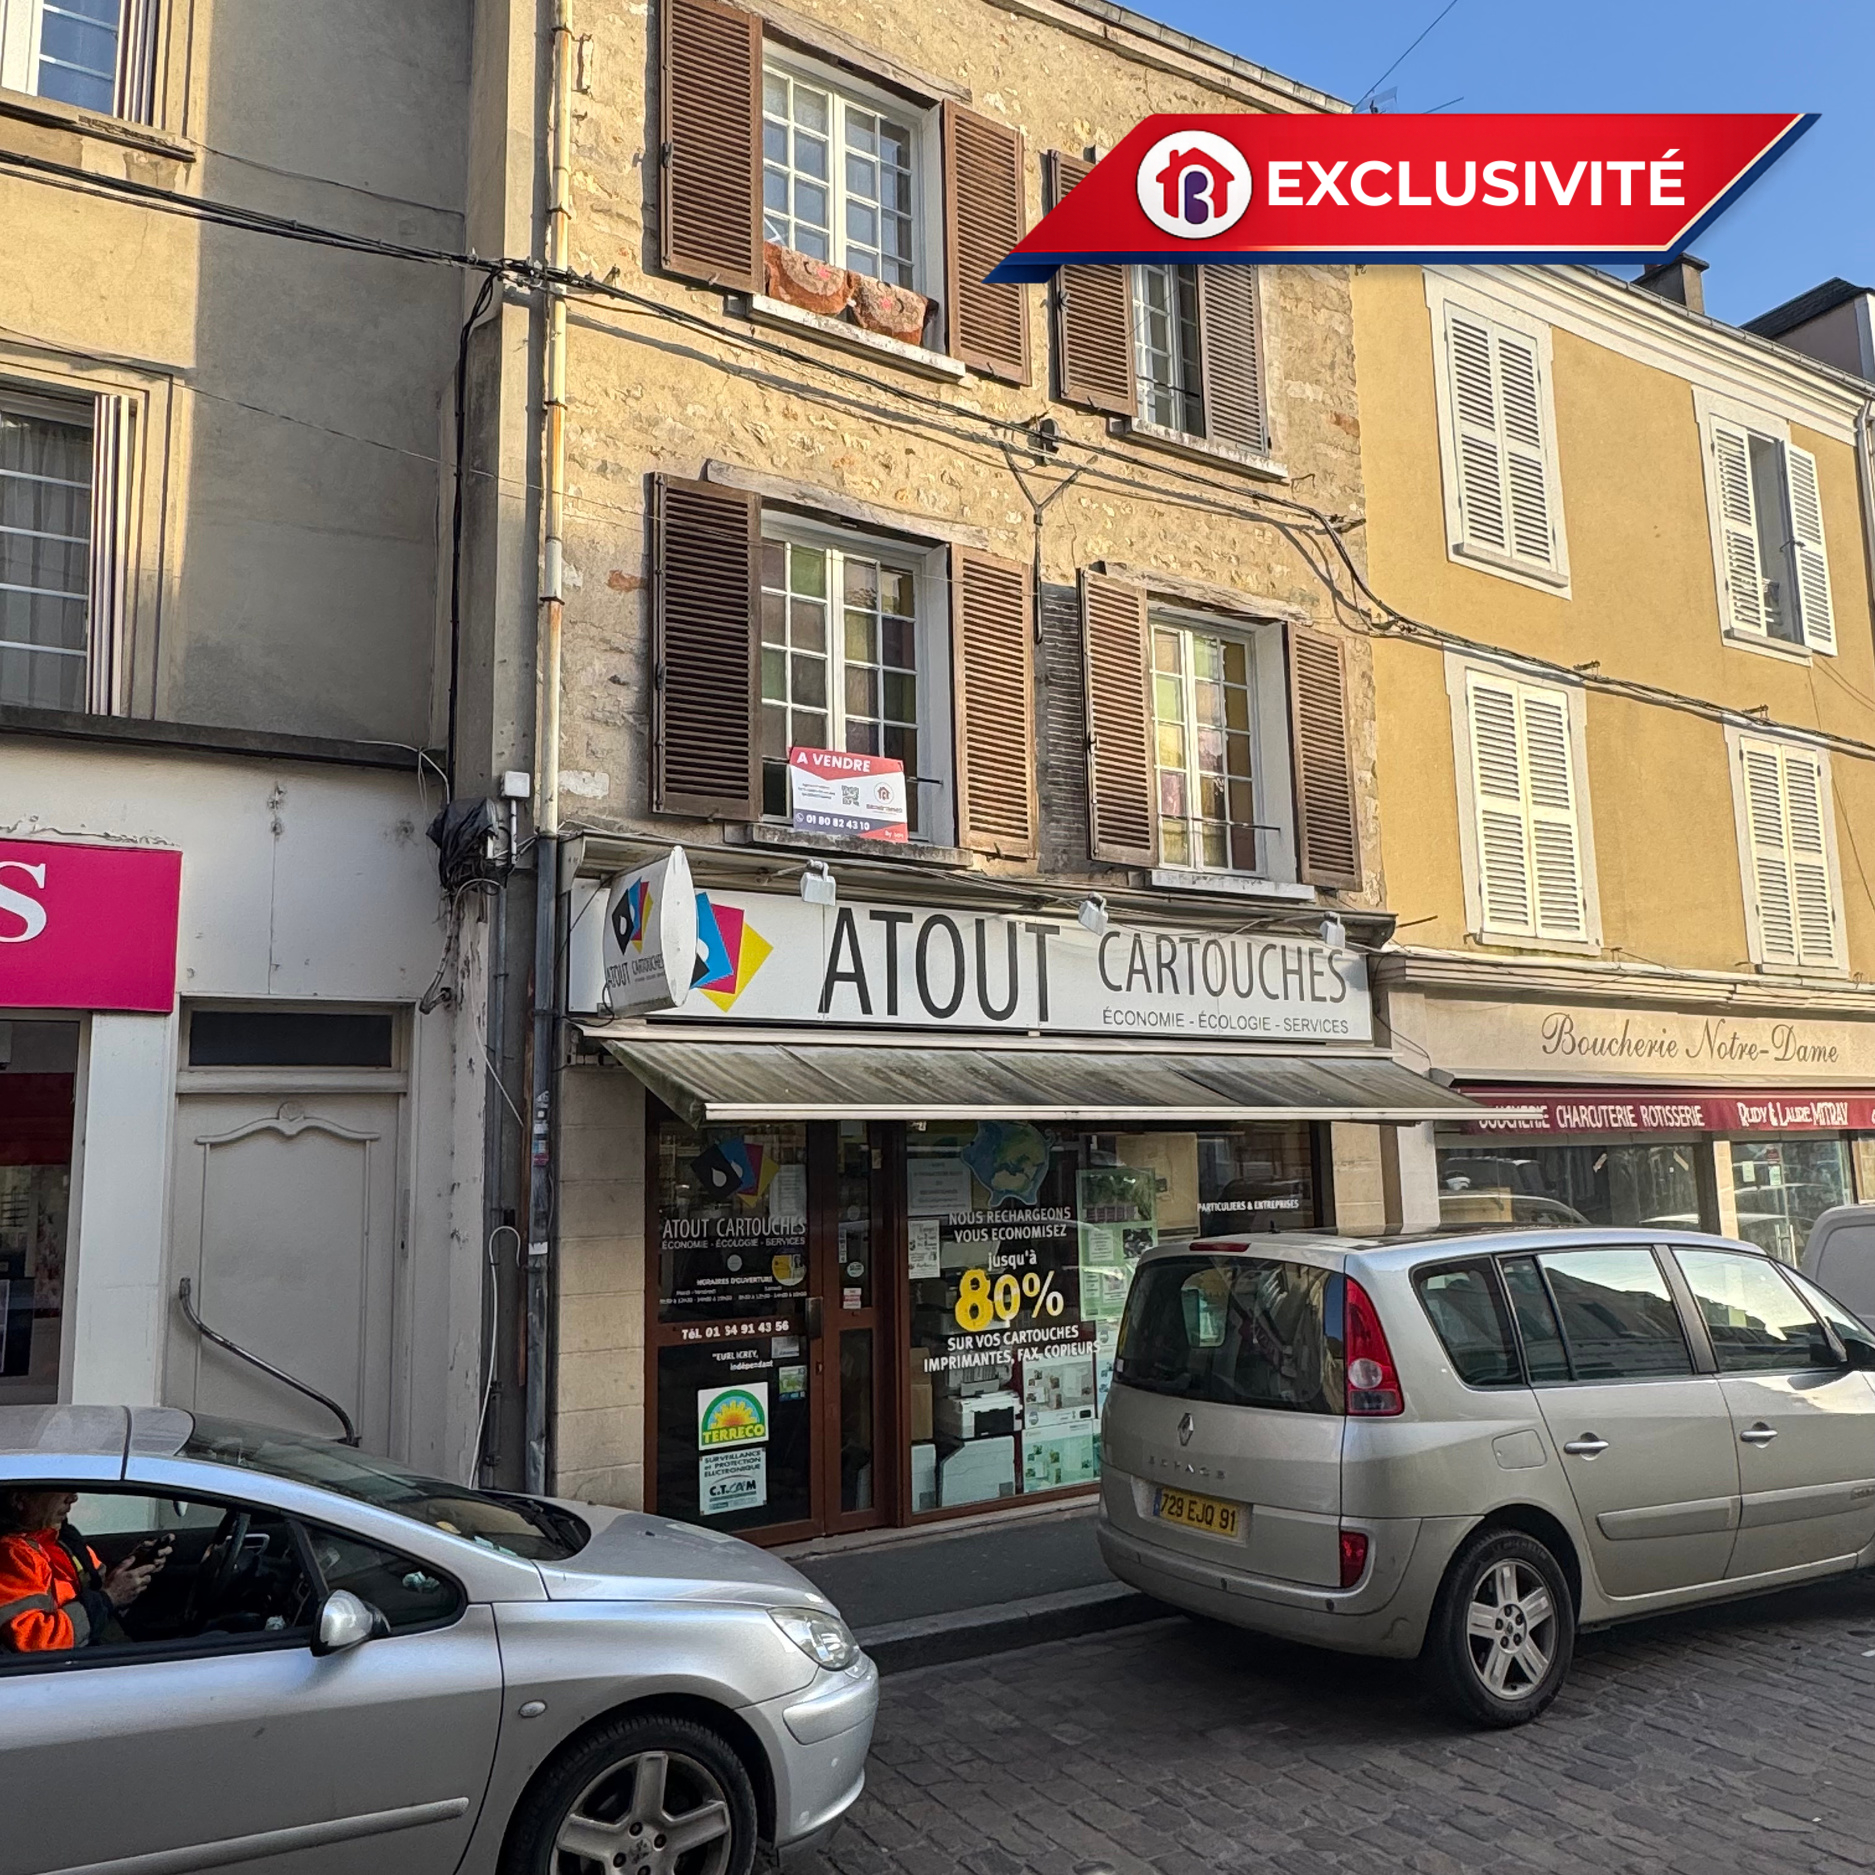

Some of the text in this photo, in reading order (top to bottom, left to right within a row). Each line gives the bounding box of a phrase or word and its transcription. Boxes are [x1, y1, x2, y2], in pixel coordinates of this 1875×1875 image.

[797, 752, 871, 772] A VENDRE
[806, 815, 817, 825] 01
[846, 821, 859, 831] 43
[859, 822, 870, 831] 10
[606, 960, 631, 989] ATOUT
[817, 906, 1347, 1022] ATOUT CARTOUCHES
[1102, 1006, 1185, 1028] ÉCONOMIE
[1198, 1013, 1271, 1032] ÉCOLOGIE
[1283, 1017, 1349, 1034] SERVICES
[1541, 1012, 1839, 1063] Boucherie Notre-Dame
[1555, 1105, 1638, 1128] CHARCUTERIE
[1639, 1105, 1705, 1127] ROTISSERIE
[949, 1206, 1072, 1226] NOUS RECHARGEONS
[1196, 1199, 1299, 1213] PARTICULIERS & ENTREPRISES
[662, 1216, 807, 1239] ATOUT CARTOUCHES
[954, 1223, 1067, 1243] VOUS ECONOMISEZ
[765, 1236, 806, 1247] SERVICES
[988, 1249, 1038, 1271] jusqu'à
[955, 1268, 1065, 1332] 80%
[706, 1326, 720, 1337] 01
[724, 1324, 738, 1336] 34
[741, 1323, 755, 1334] 91
[758, 1322, 772, 1333] 43
[775, 1320, 789, 1331] 56
[948, 1325, 1079, 1351] SUR VOS CARTOUCHES
[924, 1350, 1015, 1373] IMPRIMANTES,
[1044, 1340, 1101, 1359] COPIEURS
[702, 1423, 765, 1444] TERRECO
[704, 1450, 761, 1464] SURVEILLANCE
[714, 1456, 761, 1470] PROTECTION
[1160, 1493, 1236, 1532] 729 EJQ 91
